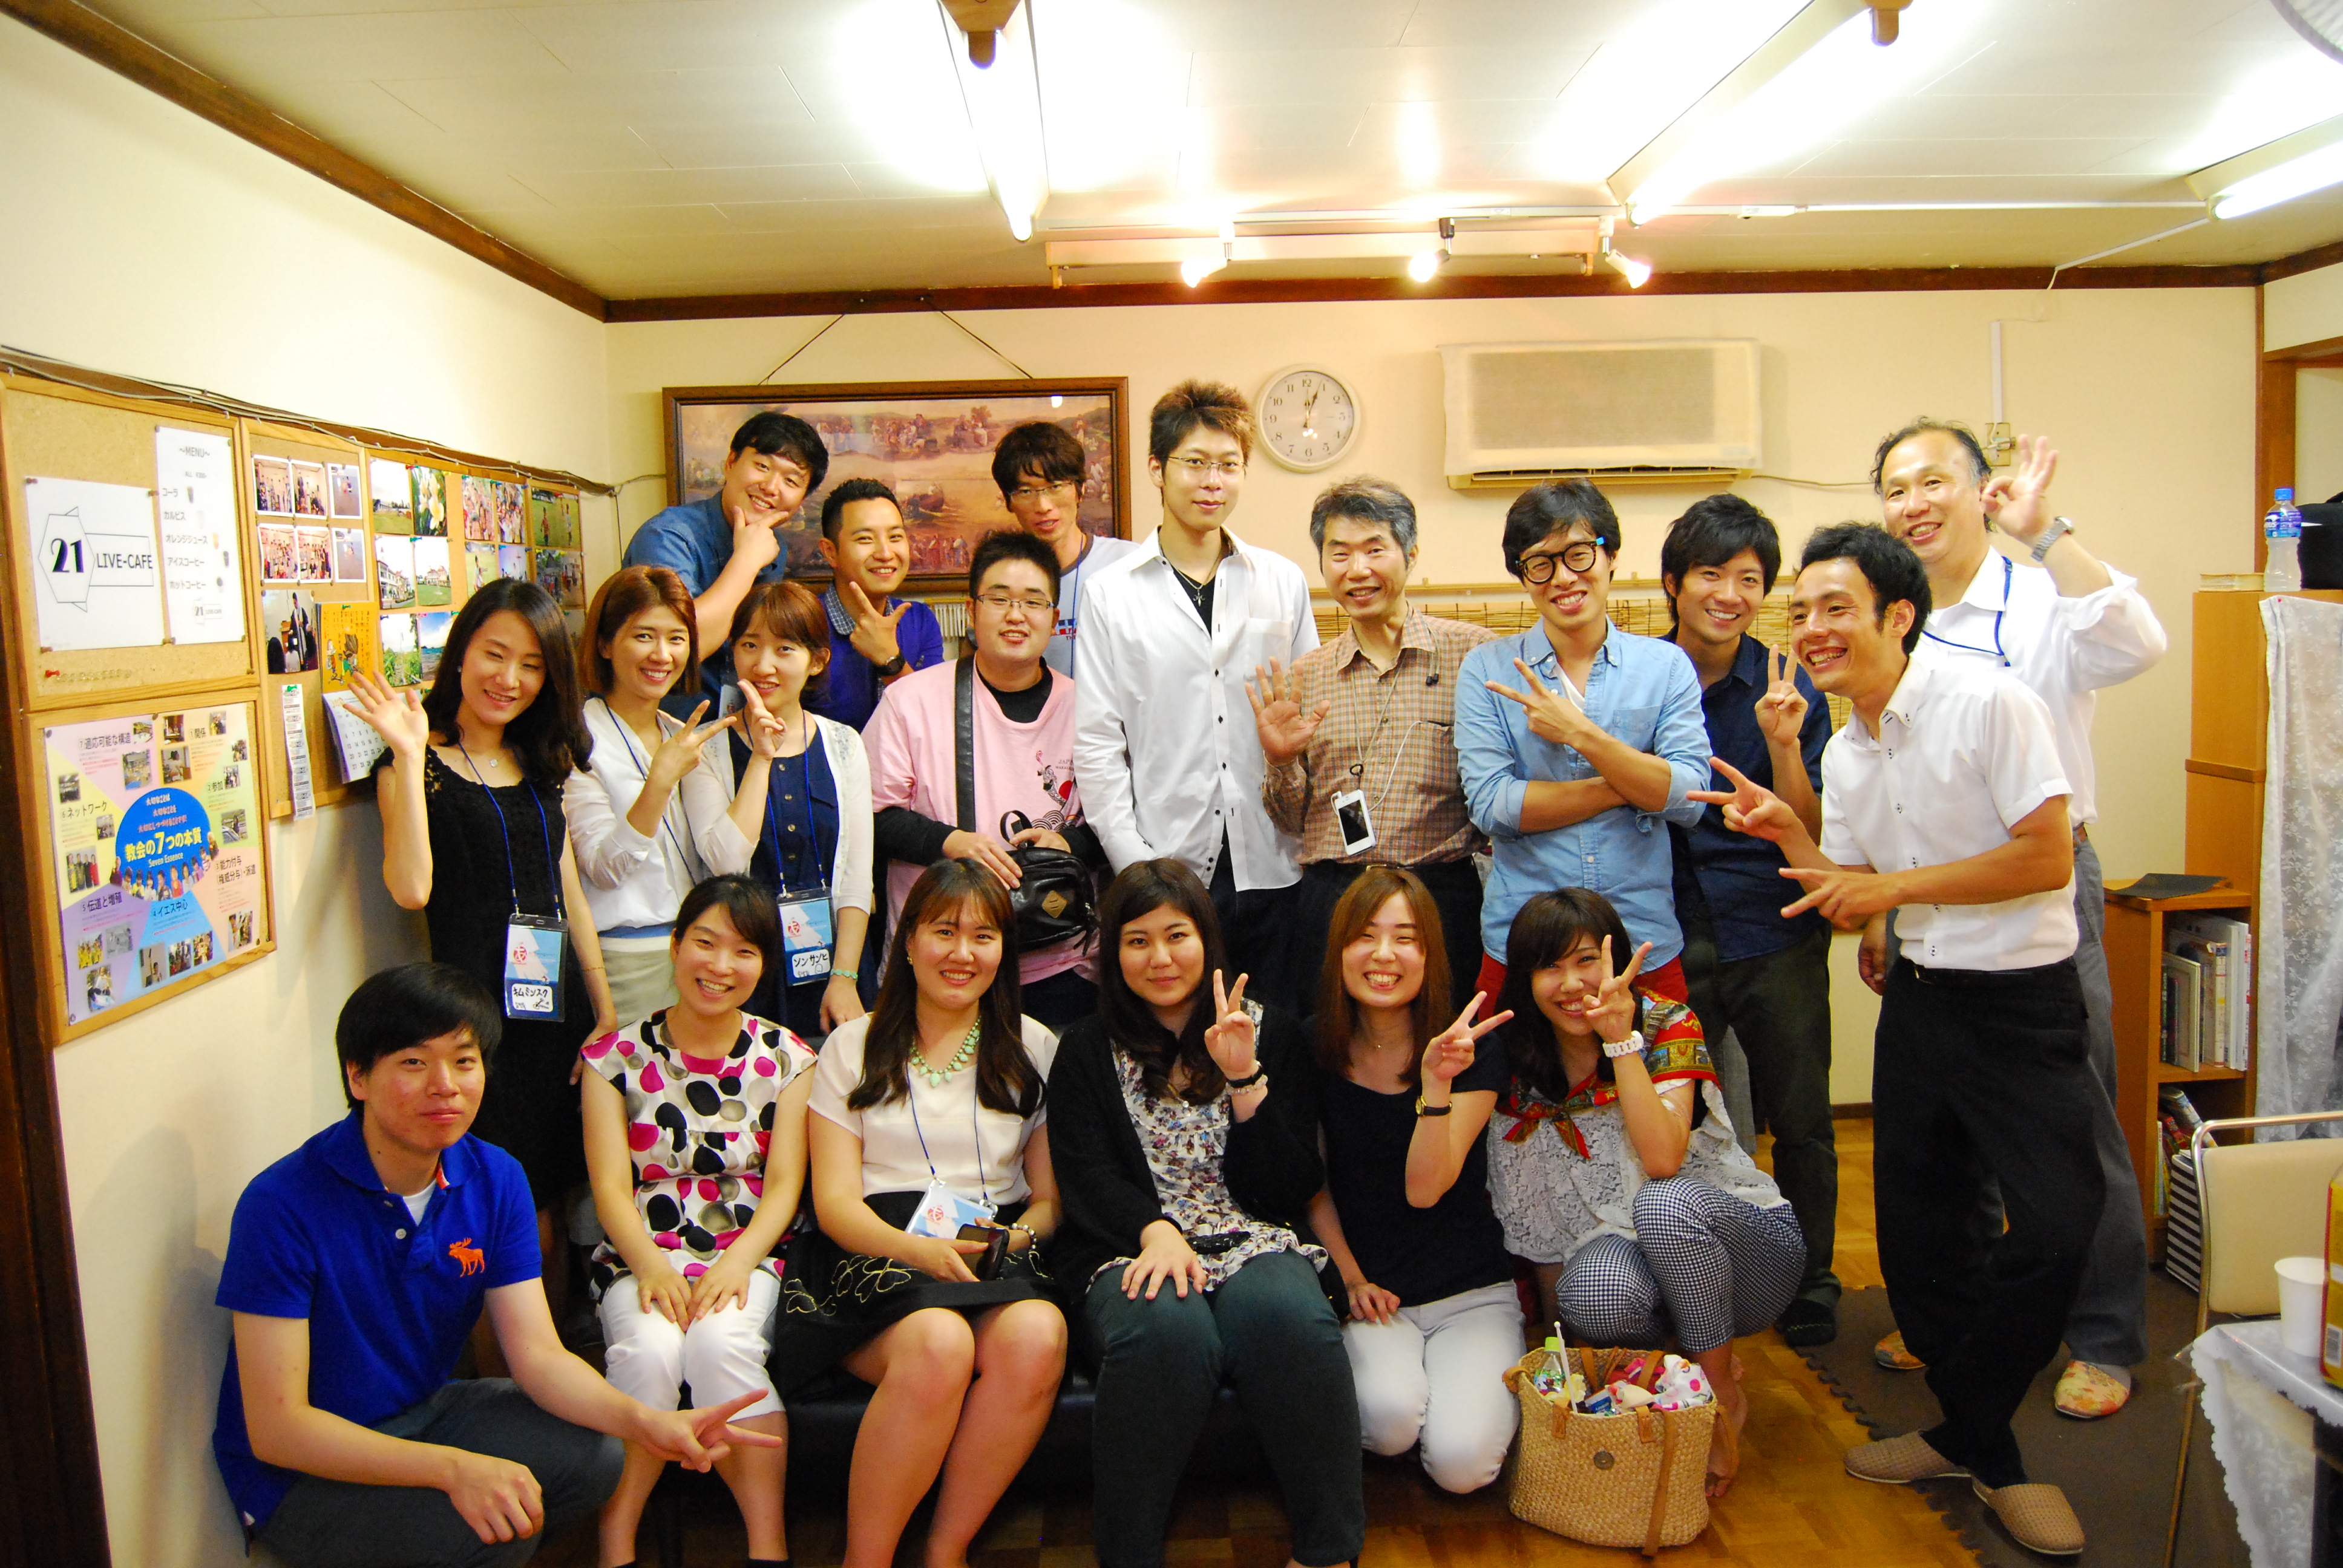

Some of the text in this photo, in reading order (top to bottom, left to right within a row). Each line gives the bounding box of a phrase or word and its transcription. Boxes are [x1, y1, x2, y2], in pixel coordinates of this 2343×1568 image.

[1302, 379, 1312, 387] 12
[1322, 383, 1326, 391] 1
[1287, 384, 1294, 393] 11
[1273, 397, 1283, 406] 10
[1333, 395, 1340, 404] 2
[1270, 414, 1277, 423] 9
[1275, 432, 1282, 440] 8
[1288, 445, 1294, 453] 7
[1323, 443, 1329, 452] 5
[1305, 448, 1312, 457] 6
[162, 488, 178, 497] コーラ
[166, 535, 208, 544] オレンジジュース
[50, 538, 84, 573] 21
[96, 553, 153, 569] LIVE-CAFE
[168, 557, 205, 567] アイスコーヒー
[169, 581, 206, 590] ホットコーヒー
[195, 606, 203, 616] 21
[125, 827, 202, 862] 教会の7つの本質
[148, 852, 183, 867] Seven Essence
